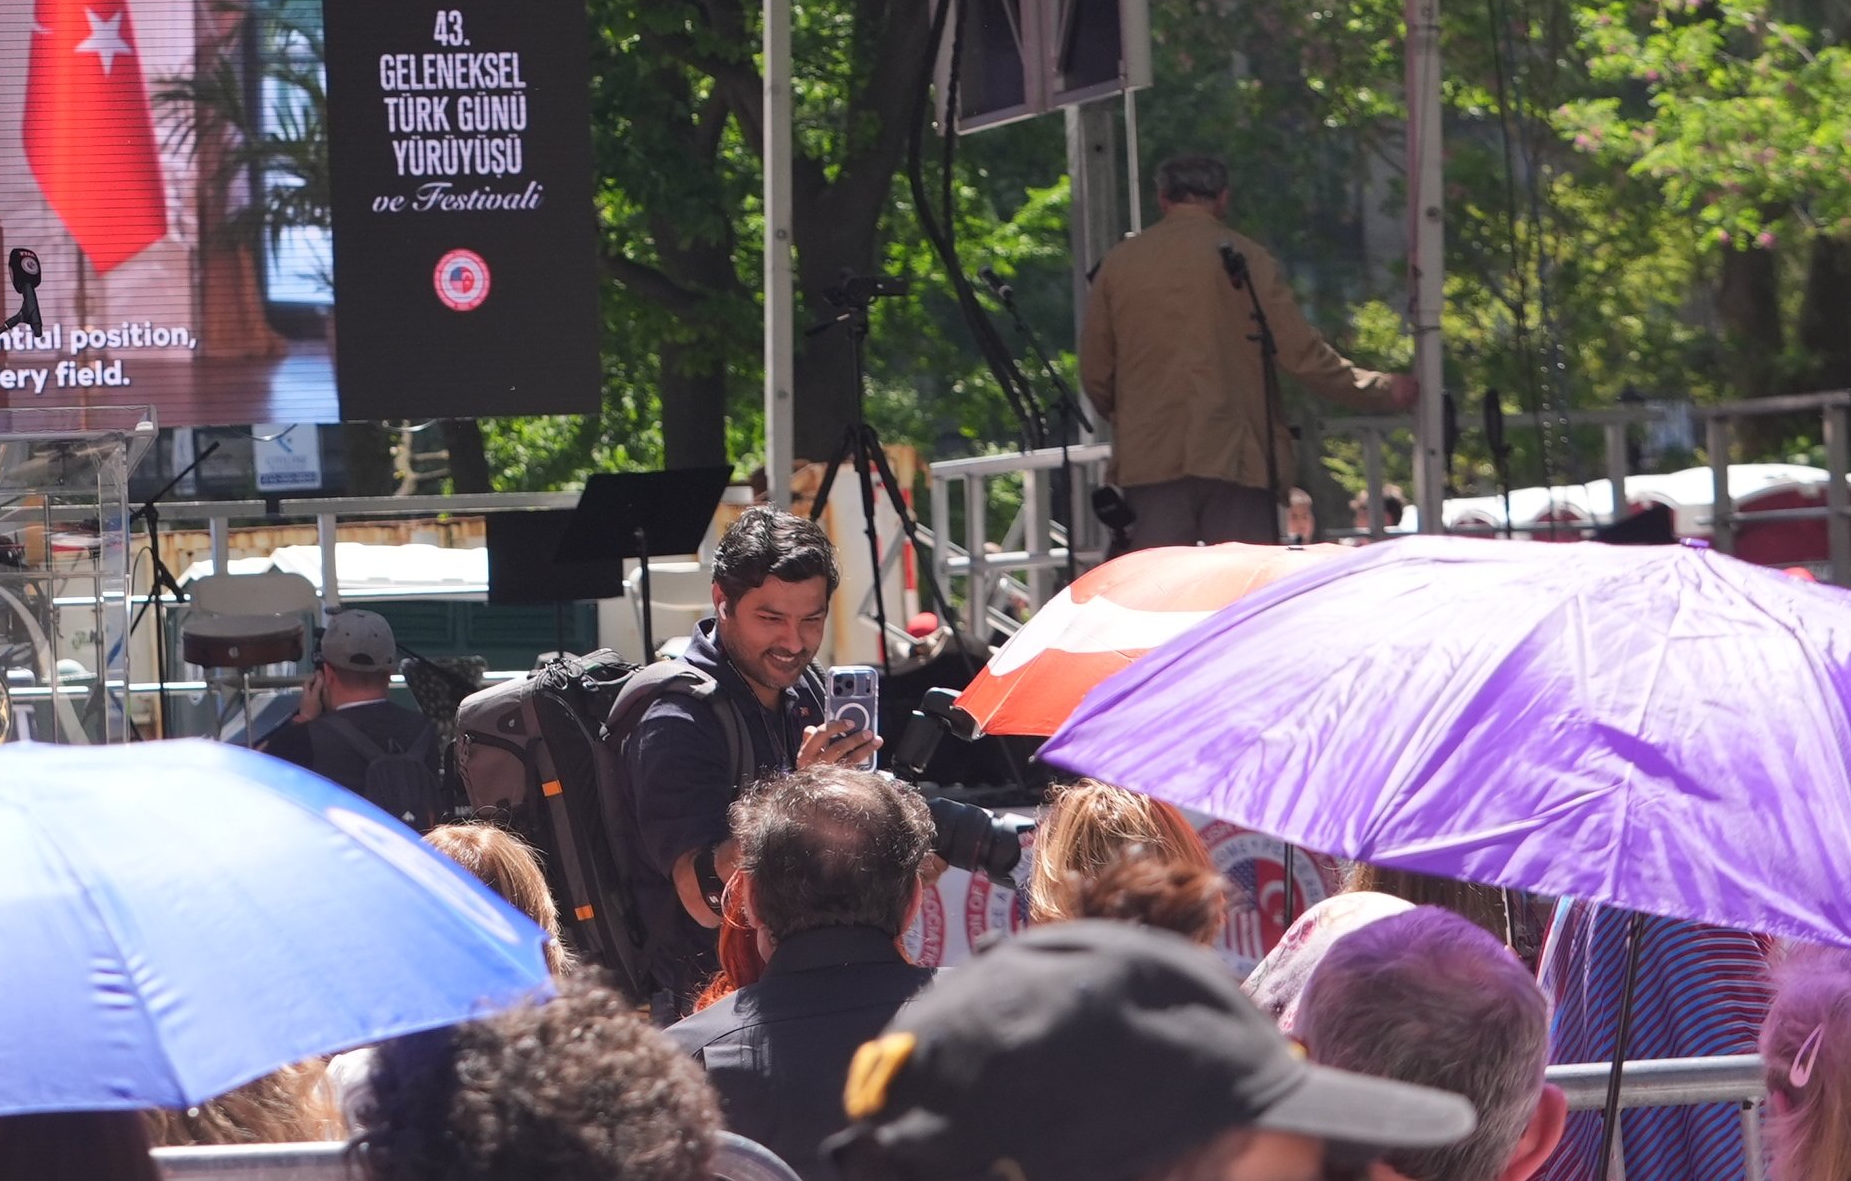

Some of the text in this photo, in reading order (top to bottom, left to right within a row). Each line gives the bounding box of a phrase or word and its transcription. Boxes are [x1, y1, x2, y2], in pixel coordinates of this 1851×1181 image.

[433, 9, 470, 46] 43.
[379, 52, 527, 91] GELENEKSEL
[383, 90, 527, 133] TÜRK GÜNÜ
[392, 133, 523, 179] YÜRÜYÜŞÜ
[372, 180, 543, 212] ve Festivali
[70, 321, 198, 355] position,
[55, 359, 131, 388] field.
